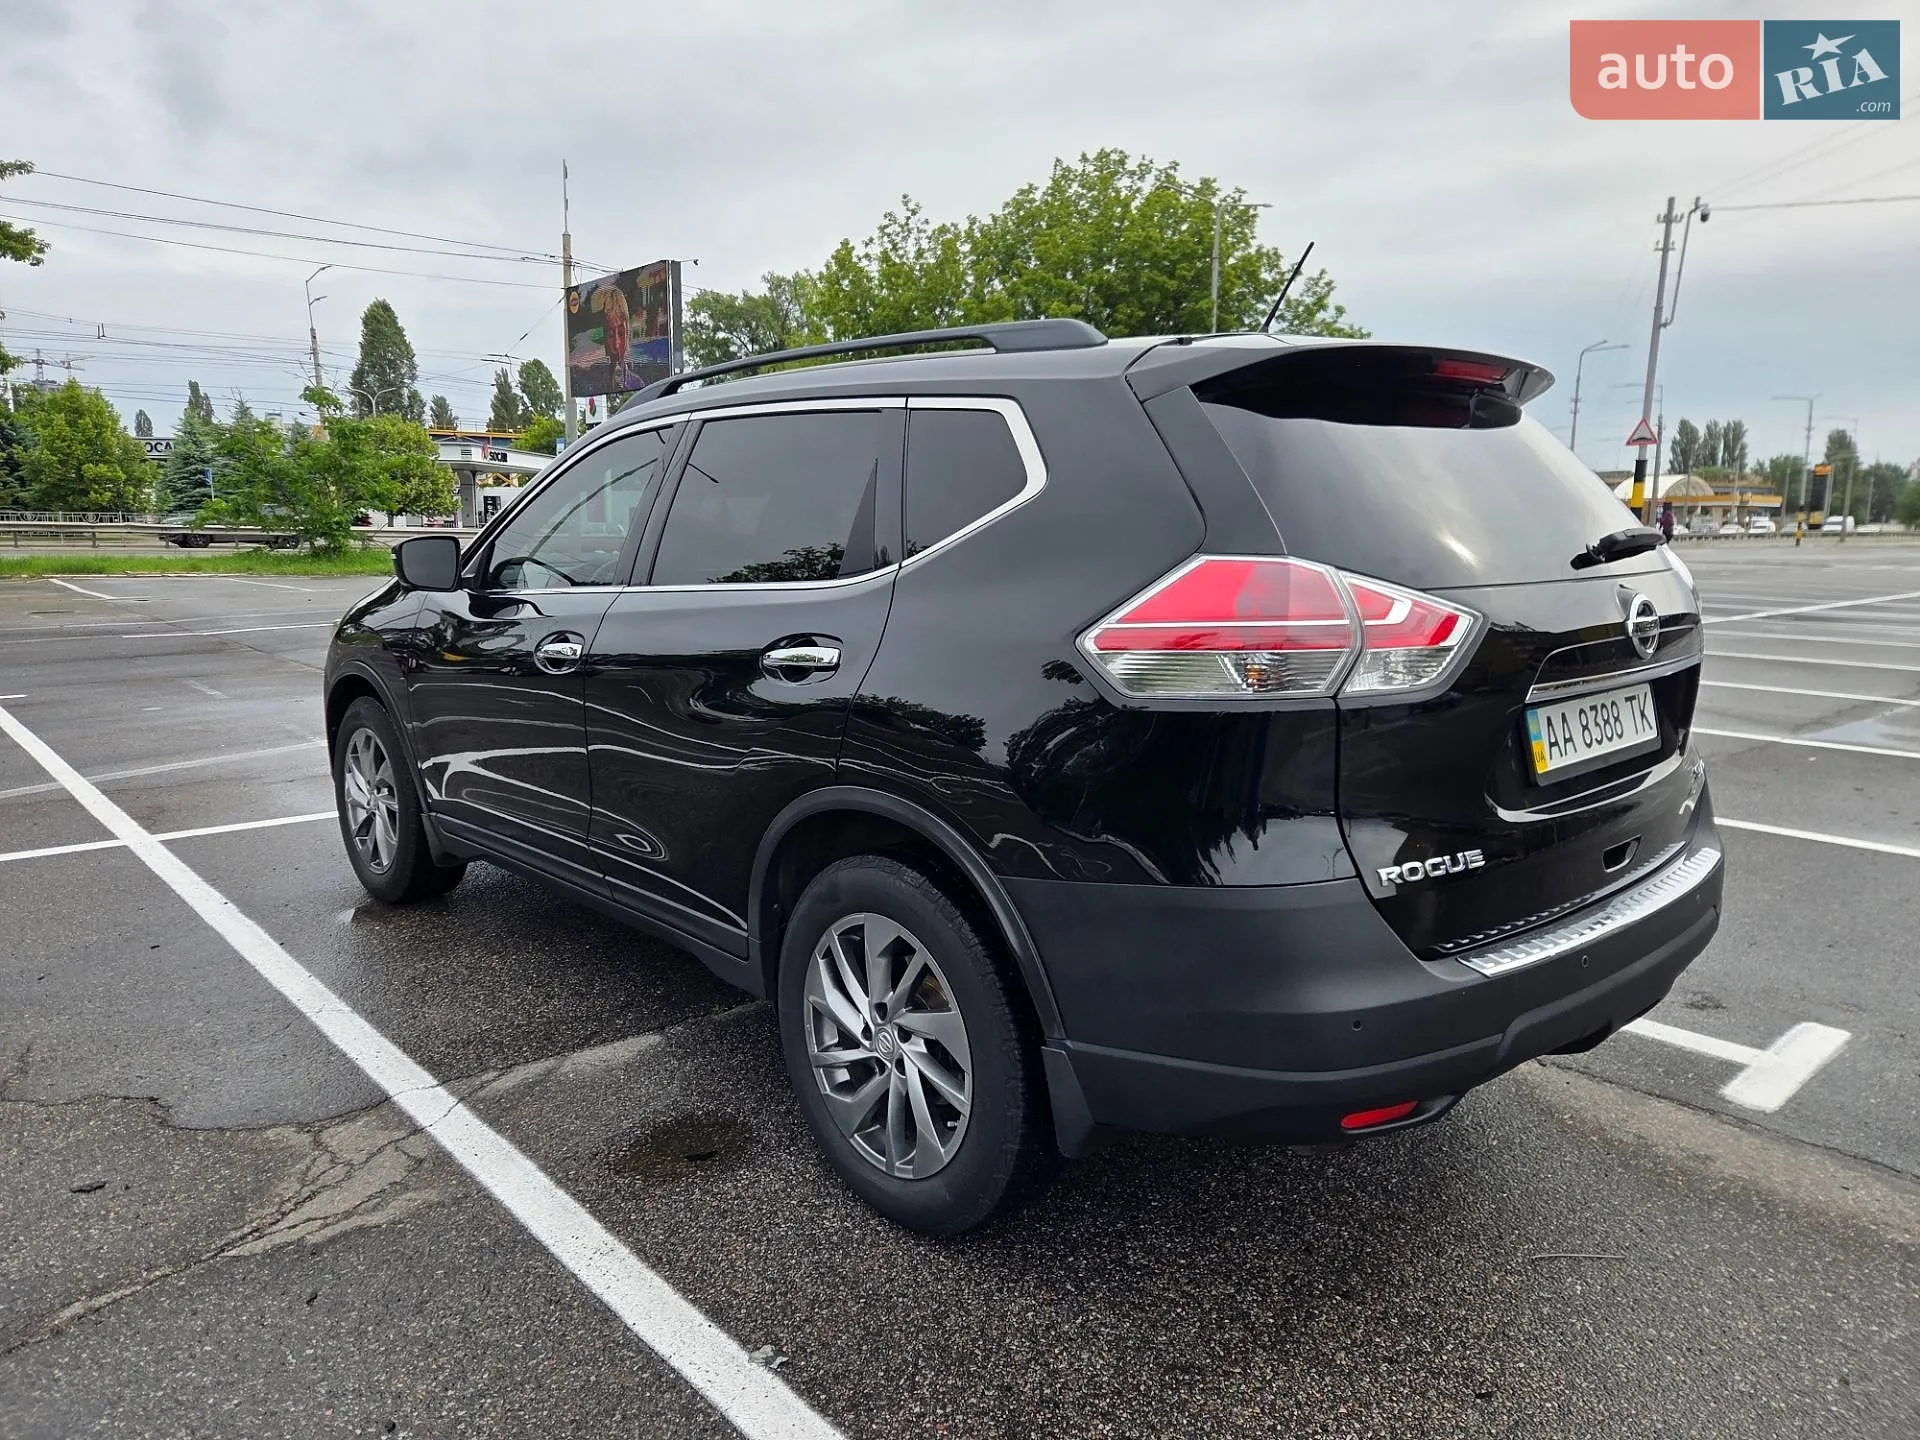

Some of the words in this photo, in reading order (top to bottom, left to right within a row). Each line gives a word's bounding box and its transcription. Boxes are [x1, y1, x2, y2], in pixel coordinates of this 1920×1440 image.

[1546, 712, 1578, 760] AA
[1579, 700, 1624, 749] 8388
[1624, 691, 1653, 735] TK
[1535, 751, 1546, 763] UA
[1376, 849, 1486, 887] ROGUE
